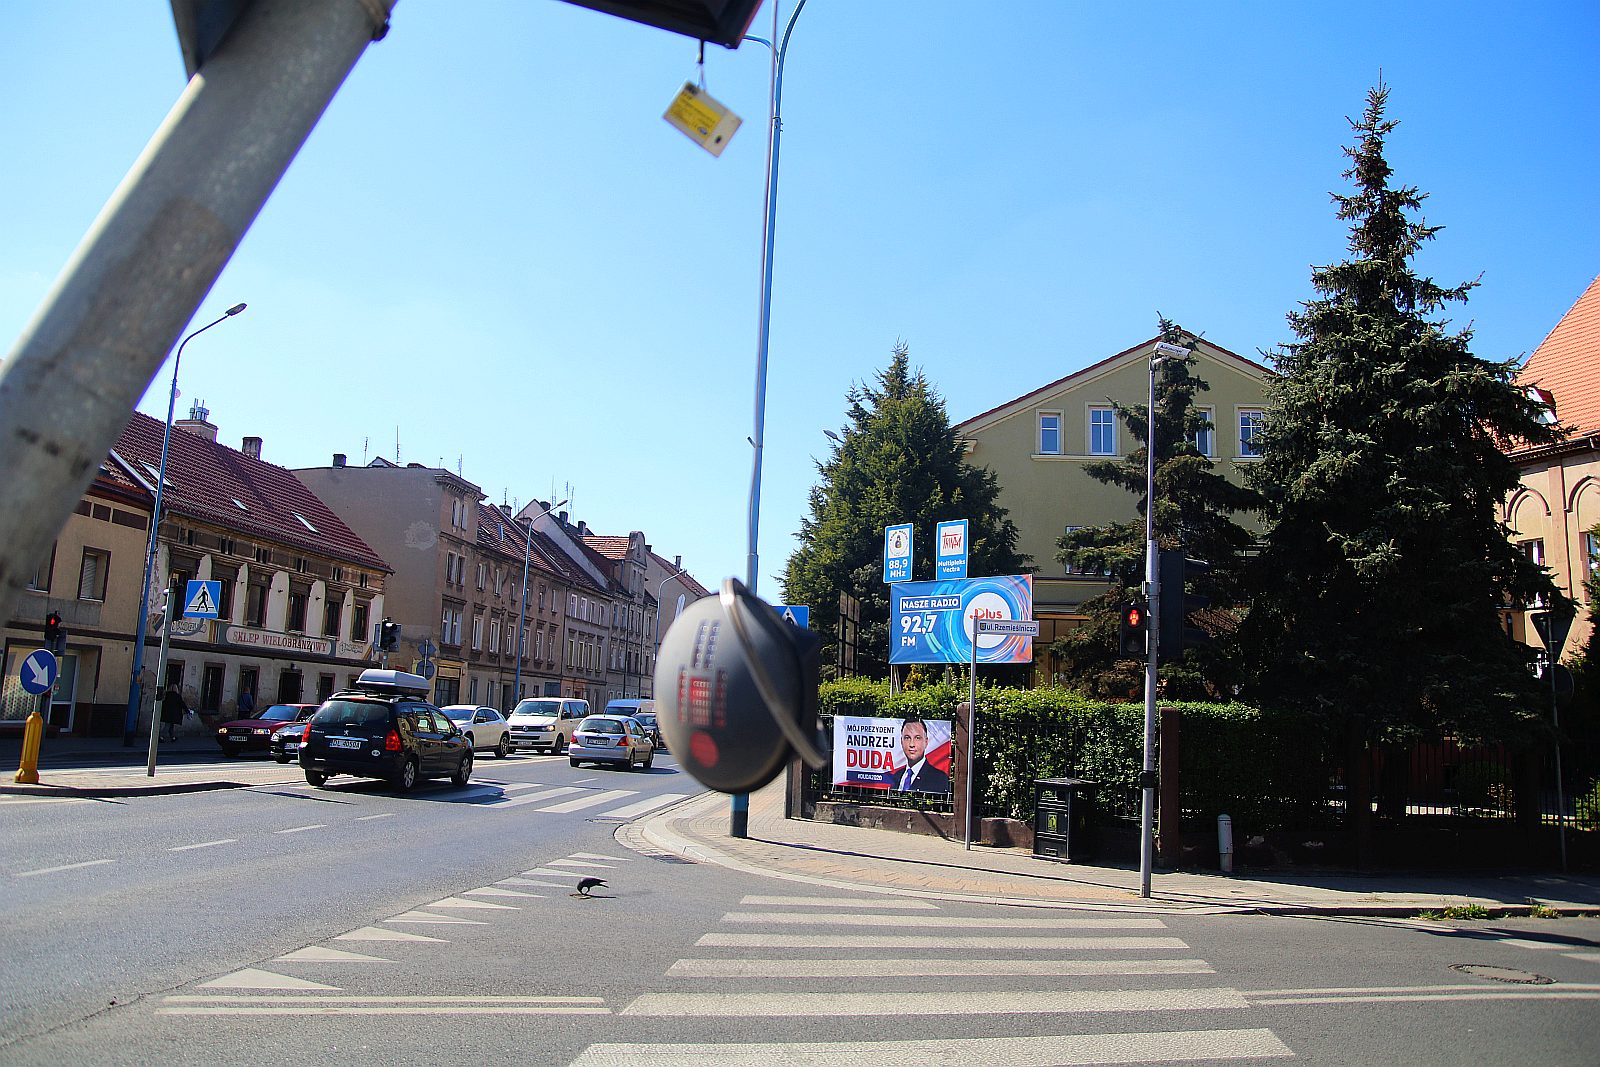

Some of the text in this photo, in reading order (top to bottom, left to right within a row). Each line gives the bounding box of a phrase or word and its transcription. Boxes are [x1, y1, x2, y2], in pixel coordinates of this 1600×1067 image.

[888, 558, 908, 569] 88,9
[889, 569, 906, 578] MHz
[902, 598, 959, 609] NASZE RADIO
[900, 615, 938, 635] 92,7
[232, 631, 260, 644] SKLEP
[901, 636, 916, 647] FM
[847, 724, 895, 734] MÓJ PREZYDENT
[846, 734, 895, 748] ANDRZEJ
[846, 748, 895, 770] DUDA
